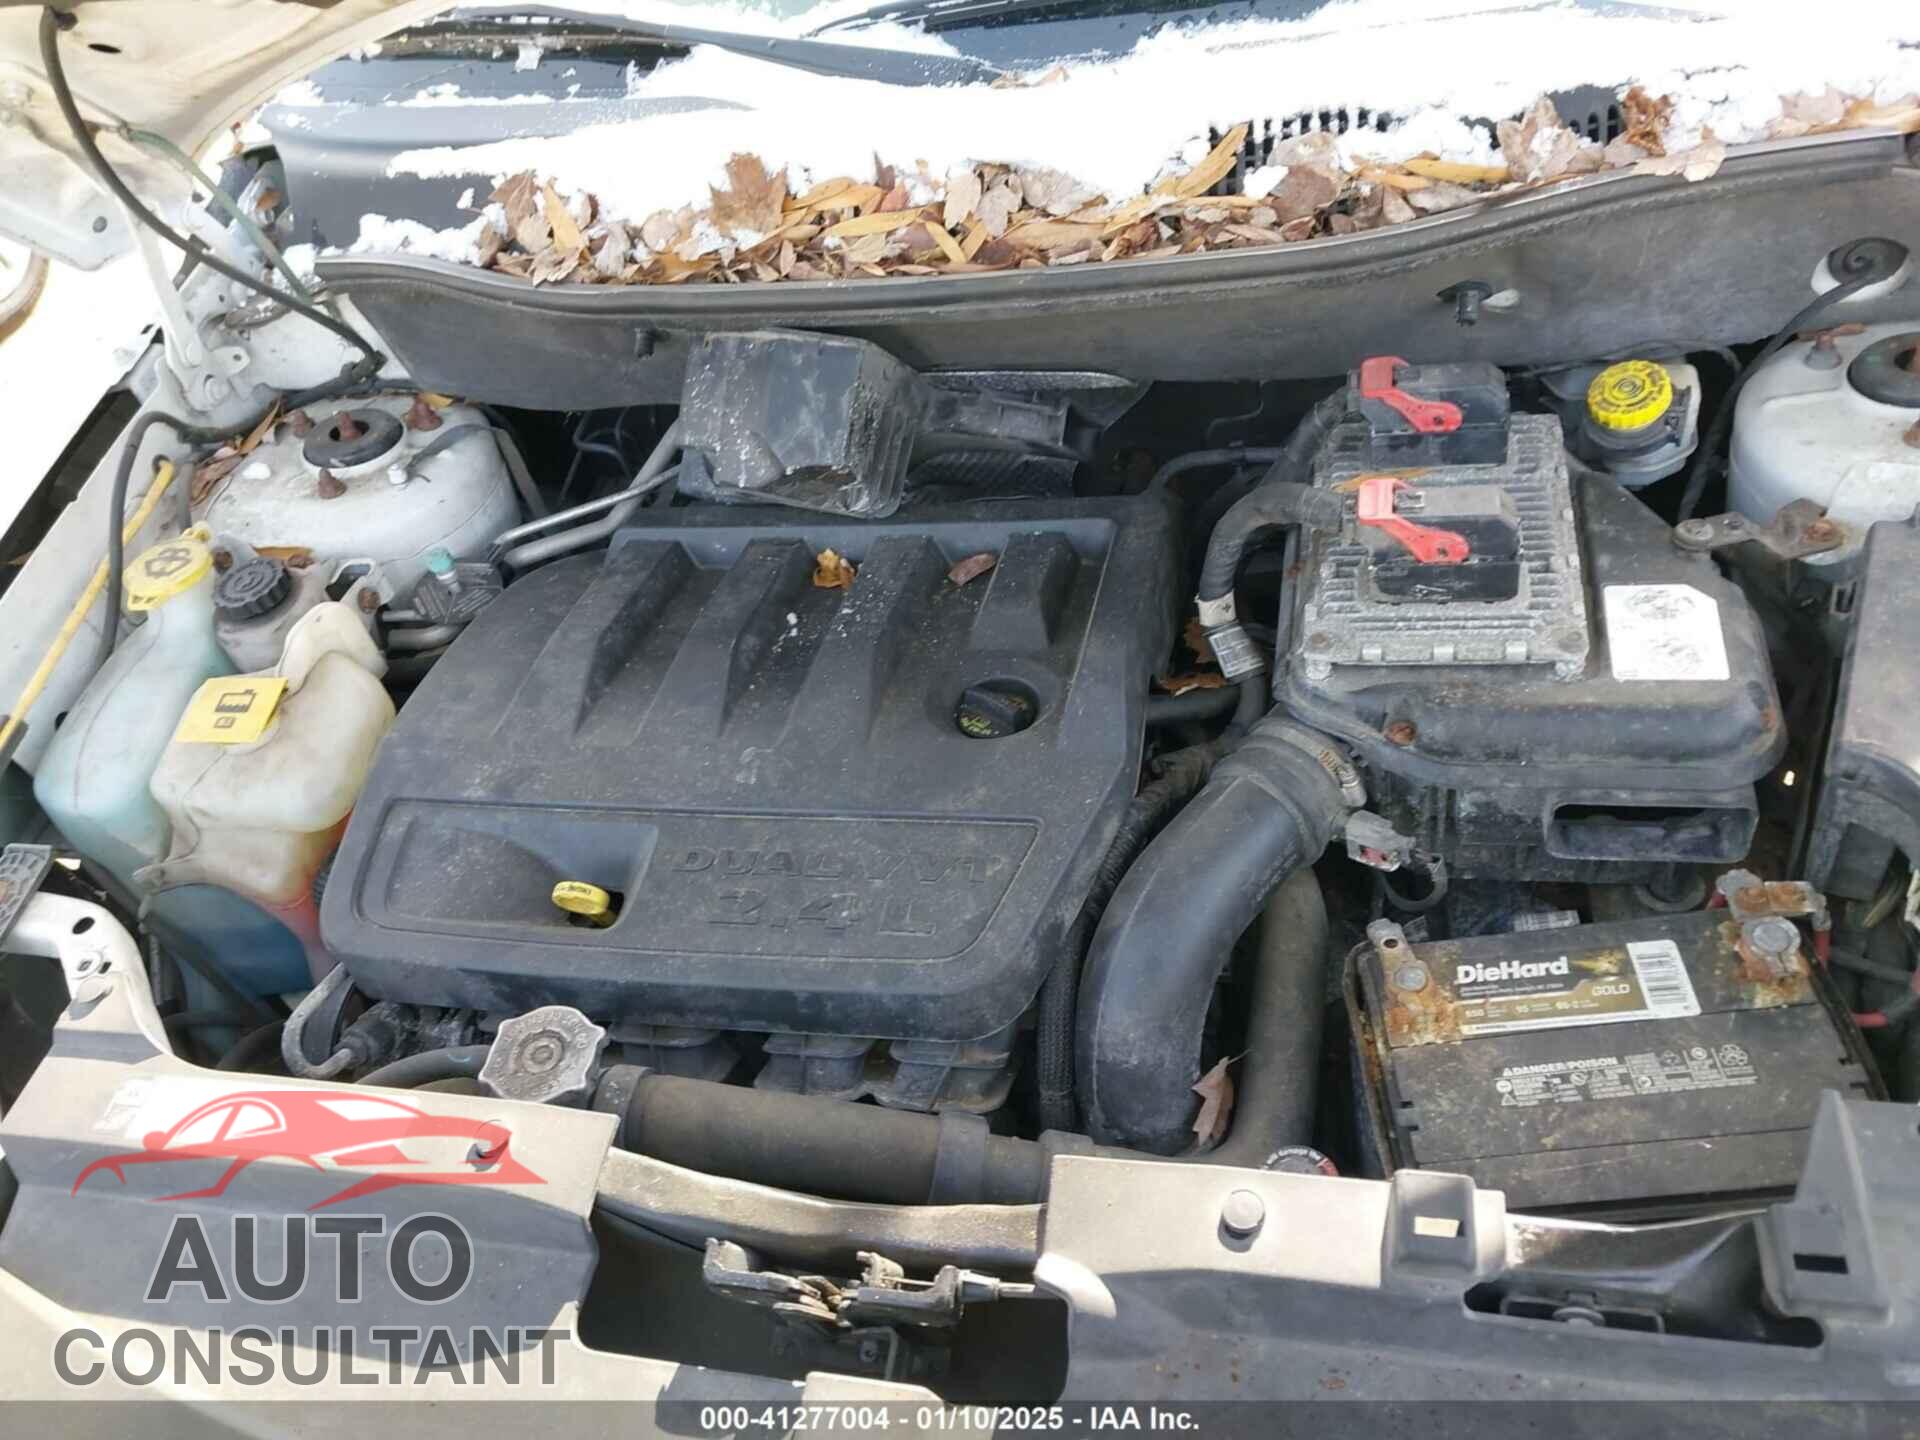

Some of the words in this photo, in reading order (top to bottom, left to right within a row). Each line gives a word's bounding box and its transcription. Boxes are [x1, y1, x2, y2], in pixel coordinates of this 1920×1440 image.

[672, 848, 841, 880] DUAL
[708, 887, 937, 936] 2.4L
[1455, 956, 1569, 984] DieHard
[1591, 983, 1631, 996] GOLD
